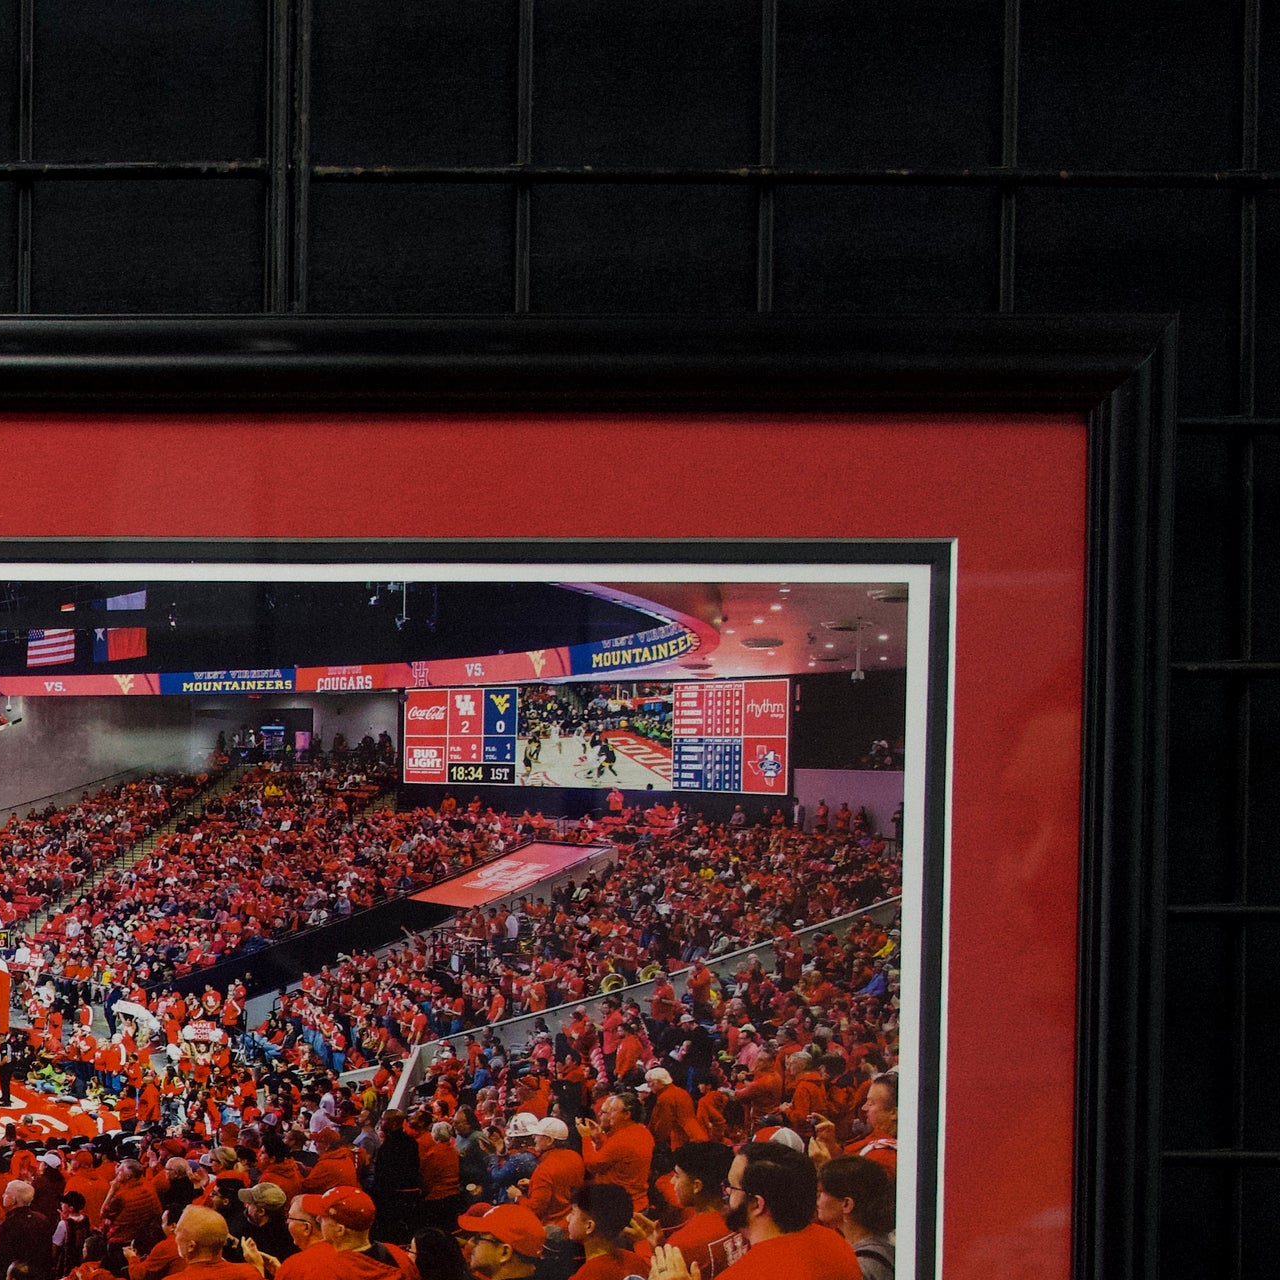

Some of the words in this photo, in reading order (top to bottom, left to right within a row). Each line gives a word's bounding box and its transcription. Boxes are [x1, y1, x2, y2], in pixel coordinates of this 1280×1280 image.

[465, 663, 485, 677] VS.
[44, 681, 66, 692] VS.
[182, 679, 293, 692] MOUNTAINEERS
[316, 675, 373, 692] COUGARS
[746, 699, 785, 718] rhythm
[461, 720, 470, 733] 2
[496, 720, 505, 733] 0
[413, 749, 437, 759] BUD
[408, 759, 442, 768] LIGHT
[450, 766, 483, 780] 18:34
[490, 768, 510, 780] 1ST
